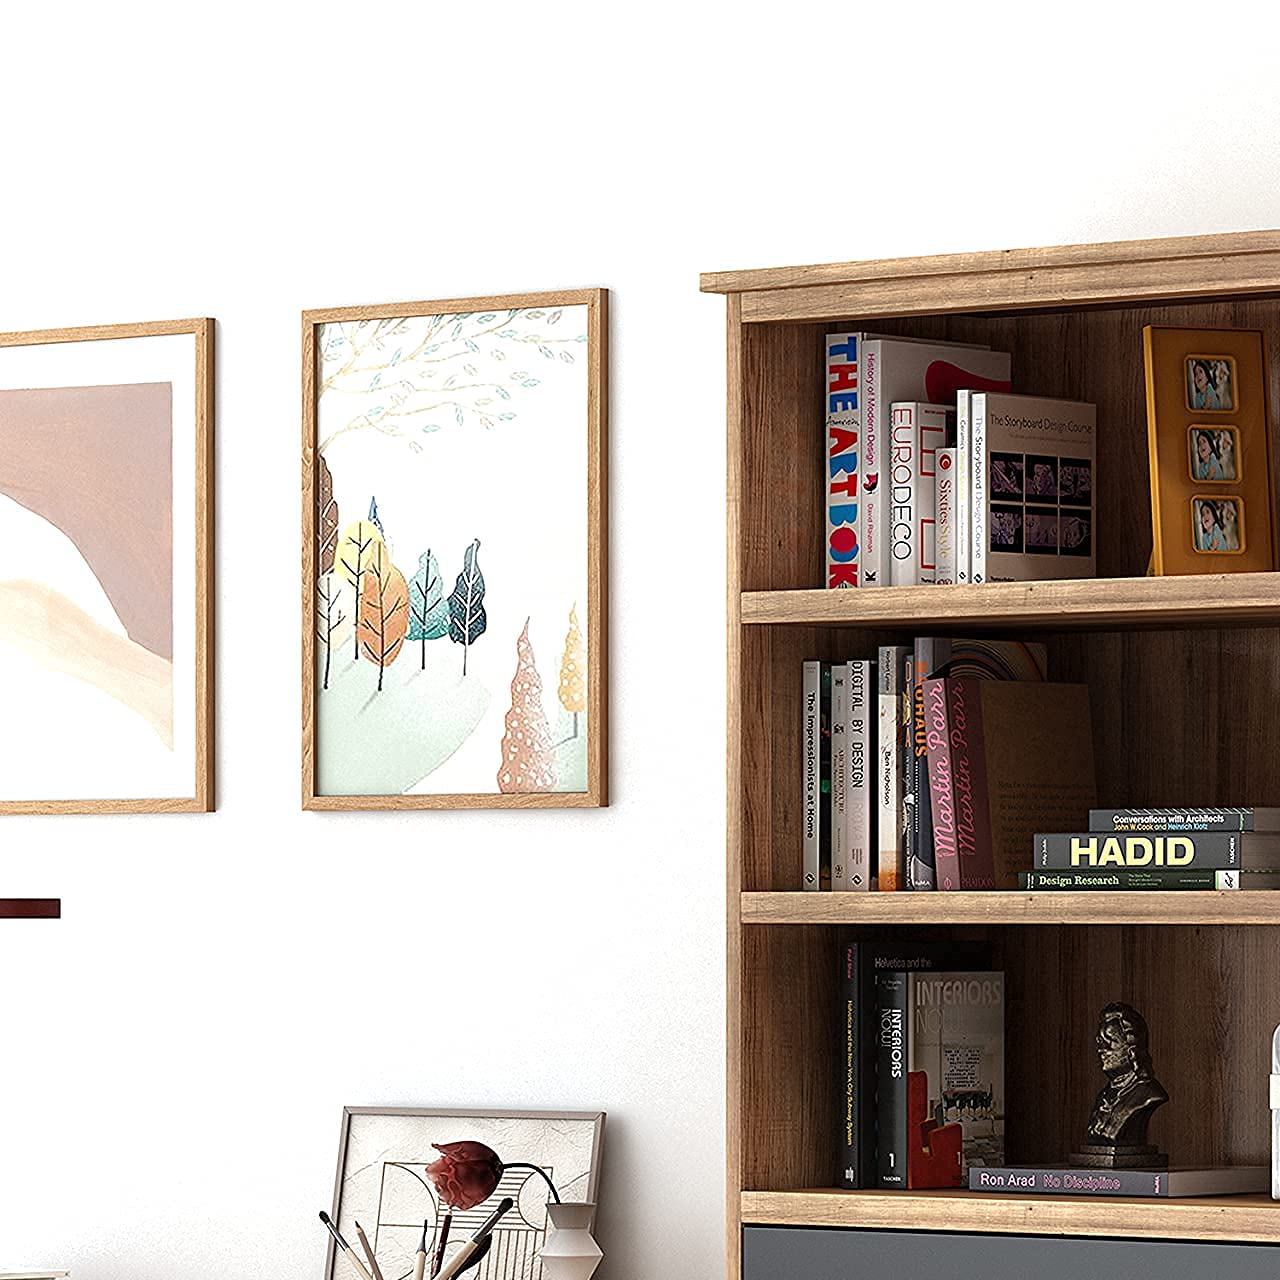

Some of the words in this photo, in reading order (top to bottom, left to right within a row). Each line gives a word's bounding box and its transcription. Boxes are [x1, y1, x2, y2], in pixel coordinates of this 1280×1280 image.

[829, 336, 859, 413] THE
[866, 353, 876, 384] History
[867, 385, 876, 395] of
[867, 397, 876, 433] Modern
[975, 415, 983, 434] The
[990, 414, 1004, 426] The
[1004, 415, 1043, 430] Storyboard
[1043, 418, 1067, 433] Design
[1067, 421, 1092, 434] Course
[865, 434, 876, 466] Design
[959, 420, 967, 450] Ceramics
[828, 427, 858, 497] ART
[972, 436, 984, 489] Storyboard
[892, 408, 912, 560] EURODECO
[866, 503, 874, 523] David
[972, 491, 983, 523] Design
[828, 504, 860, 589] BOOK
[975, 525, 983, 559] Course
[851, 661, 864, 711] DIGITAL
[806, 692, 816, 712] The
[926, 682, 947, 750] Parr
[950, 682, 969, 749] Parr
[852, 719, 864, 734] BY
[805, 714, 816, 792] Impressionists
[851, 742, 864, 789] DESIGN
[884, 751, 892, 767] Ben
[806, 794, 815, 807] at
[884, 768, 892, 805] Nicholson
[932, 757, 955, 857] Martin
[954, 756, 976, 857] Martin
[1112, 815, 1167, 825] Conversations
[1168, 815, 1185, 824] with
[1186, 815, 1224, 824] Architects
[806, 808, 816, 839] Home
[1113, 823, 1129, 831] John
[1154, 823, 1167, 831] and
[1070, 837, 1195, 867] HADID
[1039, 874, 1072, 888] Design
[1074, 874, 1120, 886] Research
[875, 957, 906, 969] Helvetica
[907, 957, 920, 969] and
[920, 957, 932, 969] the
[916, 981, 1001, 1007] INTERIORS
[881, 1008, 892, 1047] NOW!
[892, 1009, 902, 1078] INTERIORS
[888, 1153, 895, 1168] 1
[980, 1173, 1004, 1187] Ron
[1007, 1174, 1035, 1188] Arad
[1043, 1174, 1061, 1188] No
[1063, 1175, 1121, 1191] Discipline
